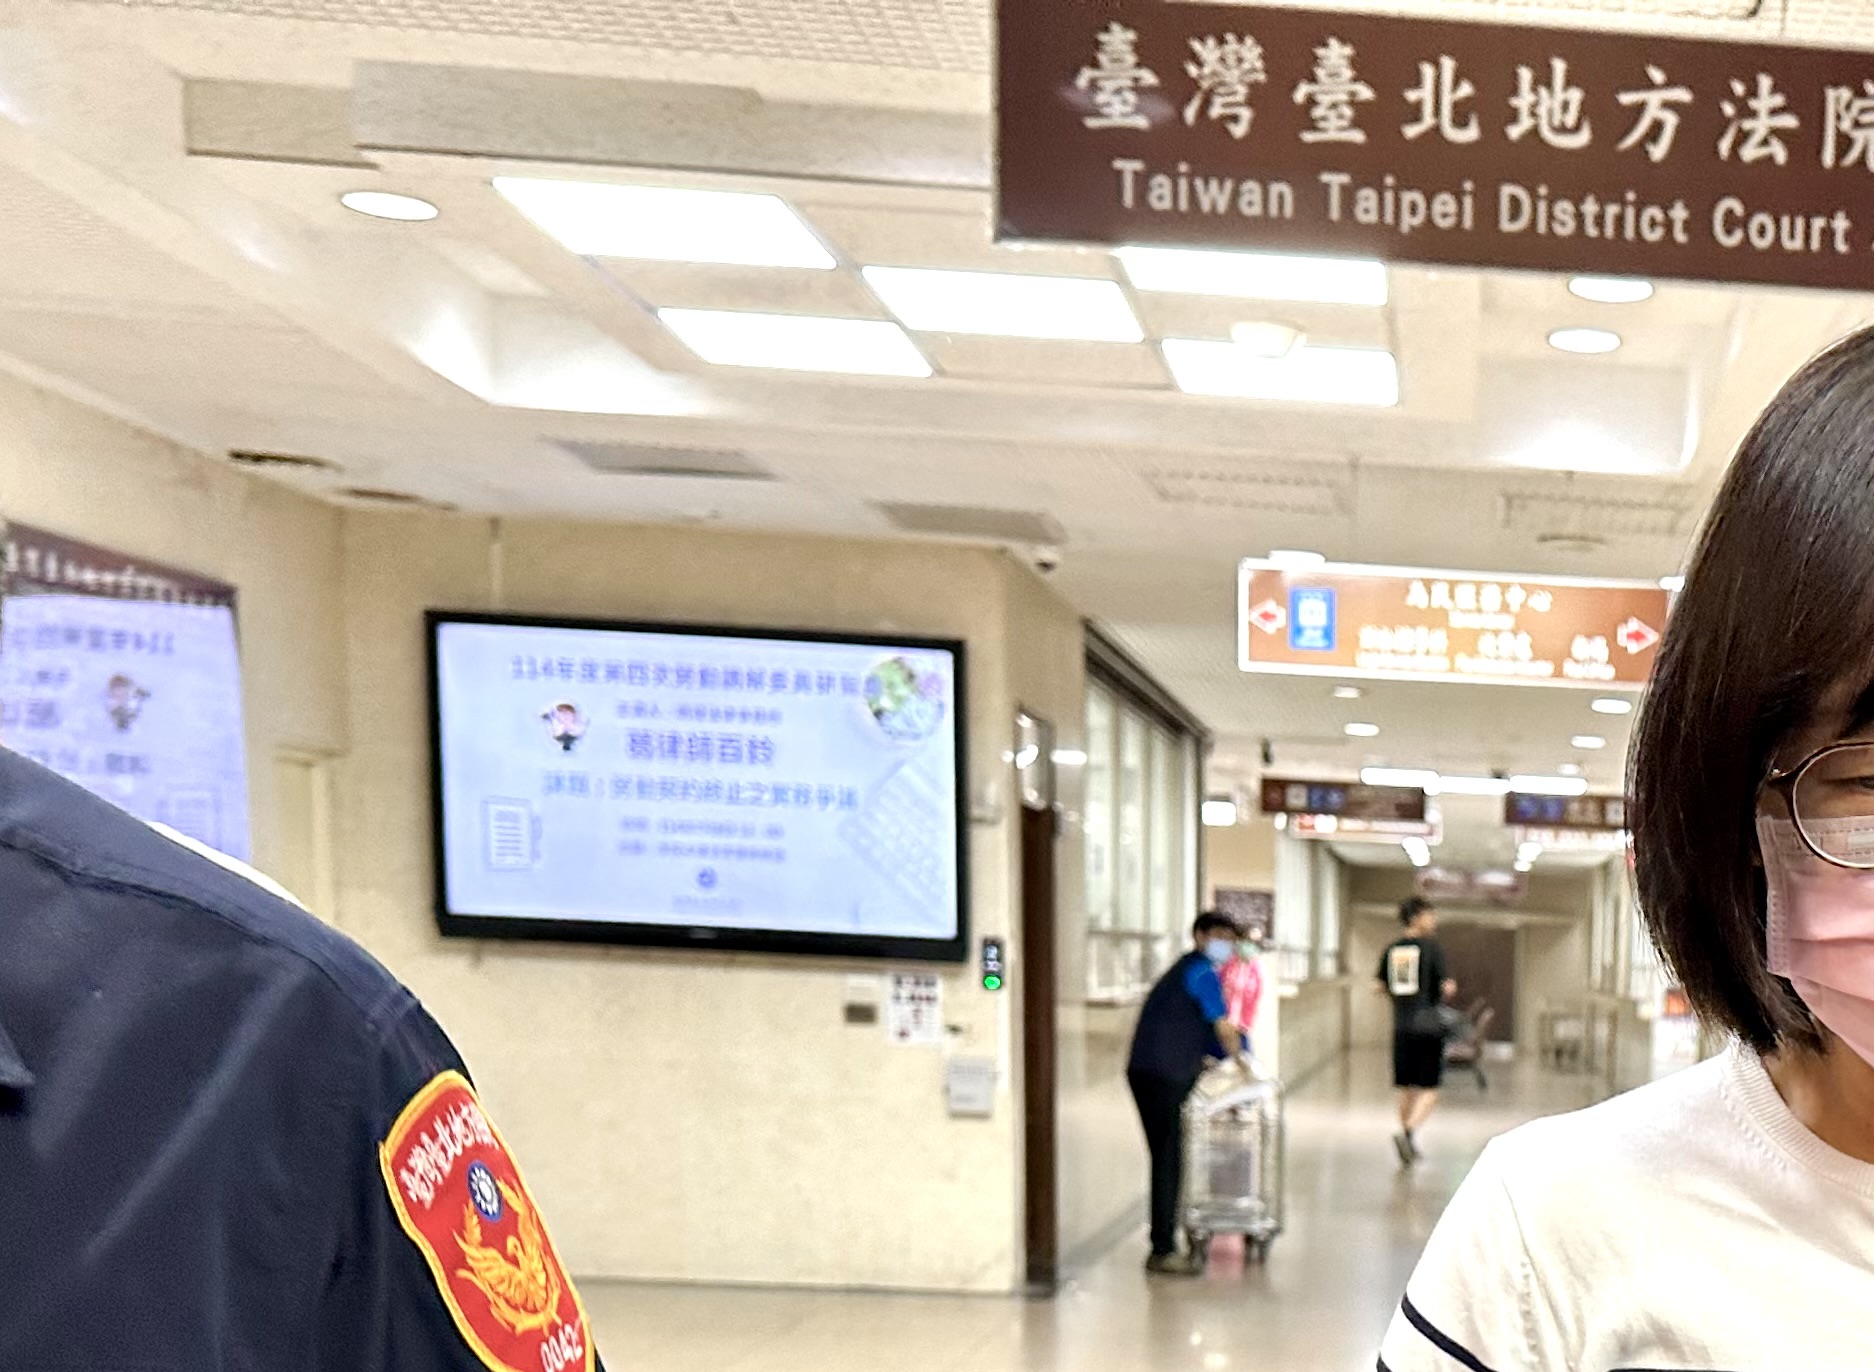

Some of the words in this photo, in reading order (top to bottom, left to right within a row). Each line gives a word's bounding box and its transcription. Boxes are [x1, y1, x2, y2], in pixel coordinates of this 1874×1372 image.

[1111, 158, 1295, 219] Taiwan
[1317, 171, 1475, 235] Taipei
[1498, 183, 1690, 245] District
[1711, 196, 1851, 255] Court
